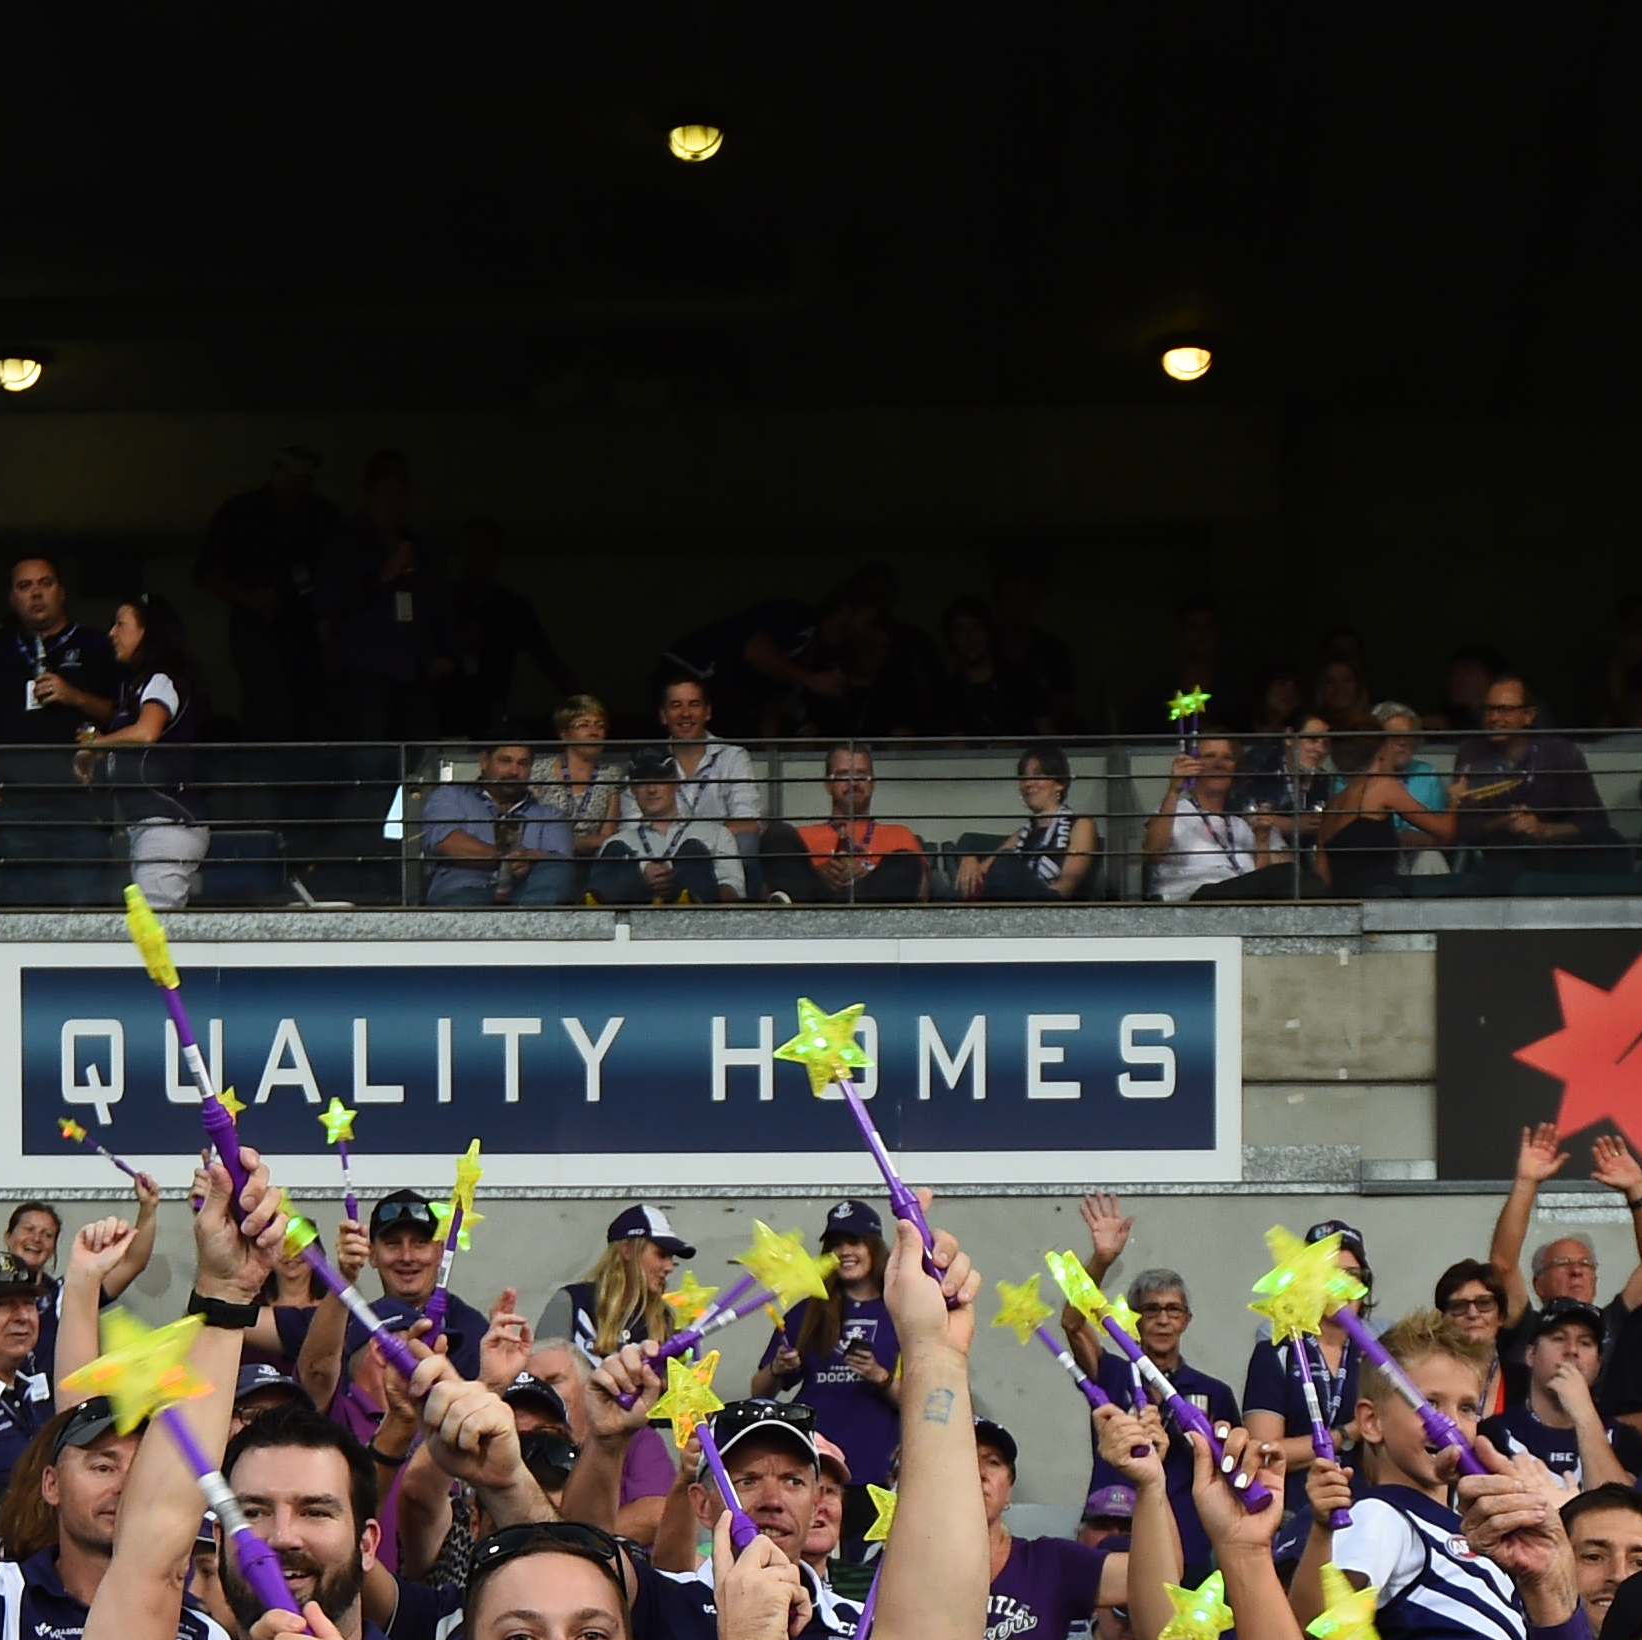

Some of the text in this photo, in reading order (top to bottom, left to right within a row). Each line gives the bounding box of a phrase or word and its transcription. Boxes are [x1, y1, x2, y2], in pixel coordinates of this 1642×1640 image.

[59, 1012, 1176, 1125] QUALITY HMES
[816, 1370, 864, 1384] DOCK
